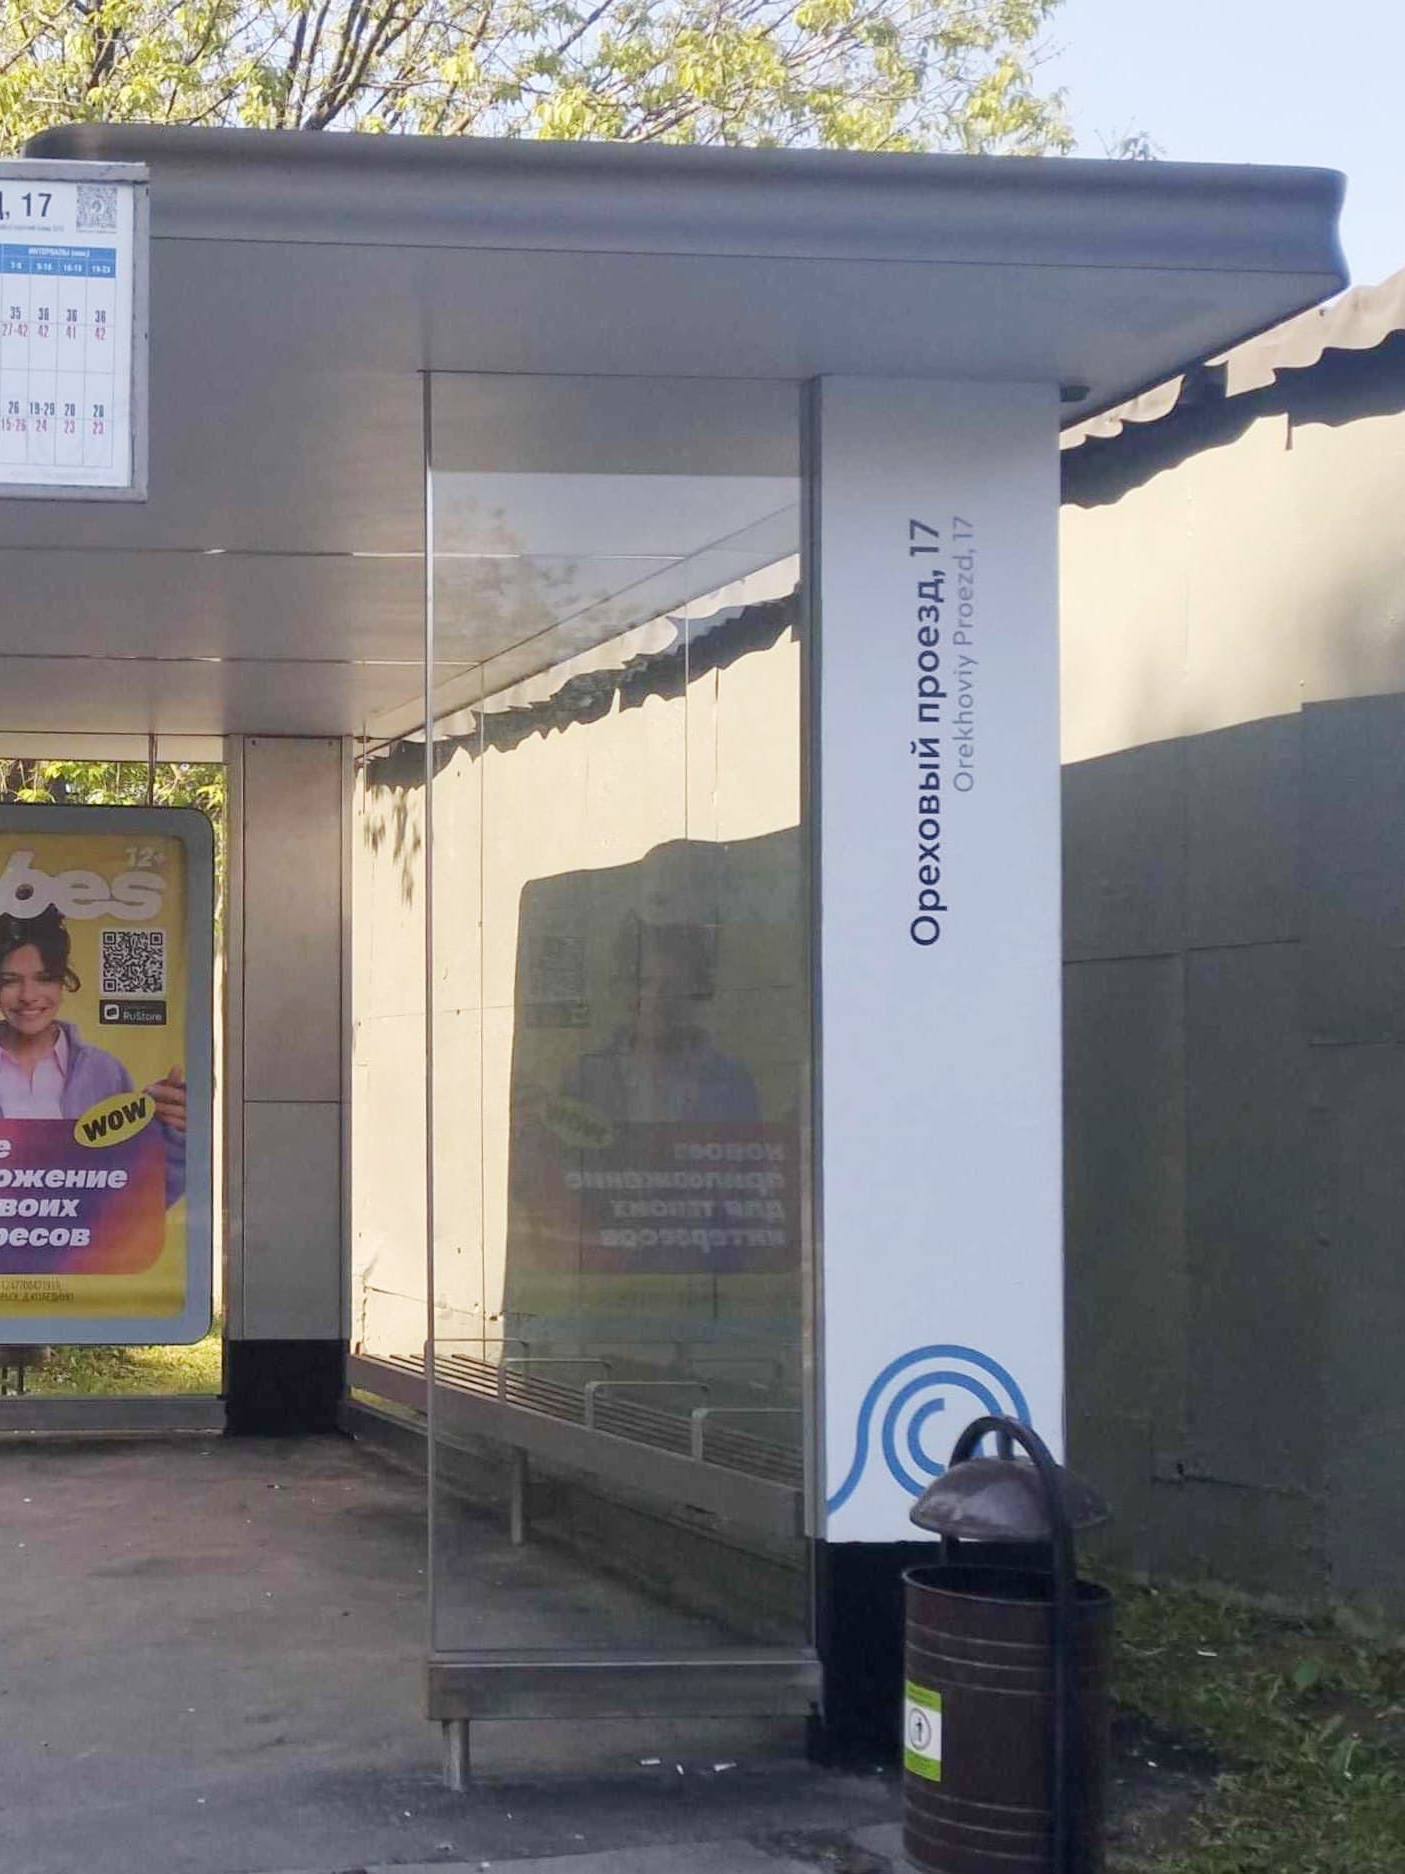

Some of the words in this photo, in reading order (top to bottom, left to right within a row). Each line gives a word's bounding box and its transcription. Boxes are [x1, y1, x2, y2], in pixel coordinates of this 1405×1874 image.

[21, 193, 52, 216] 17
[909, 519, 939, 556] 17
[952, 516, 974, 541] 17
[952, 549, 977, 645] Proezd,
[918, 570, 947, 723] проезд,
[952, 654, 979, 792] Orekhoviy
[910, 737, 947, 946] Ореховый
[82, 1098, 147, 1142] WOW
